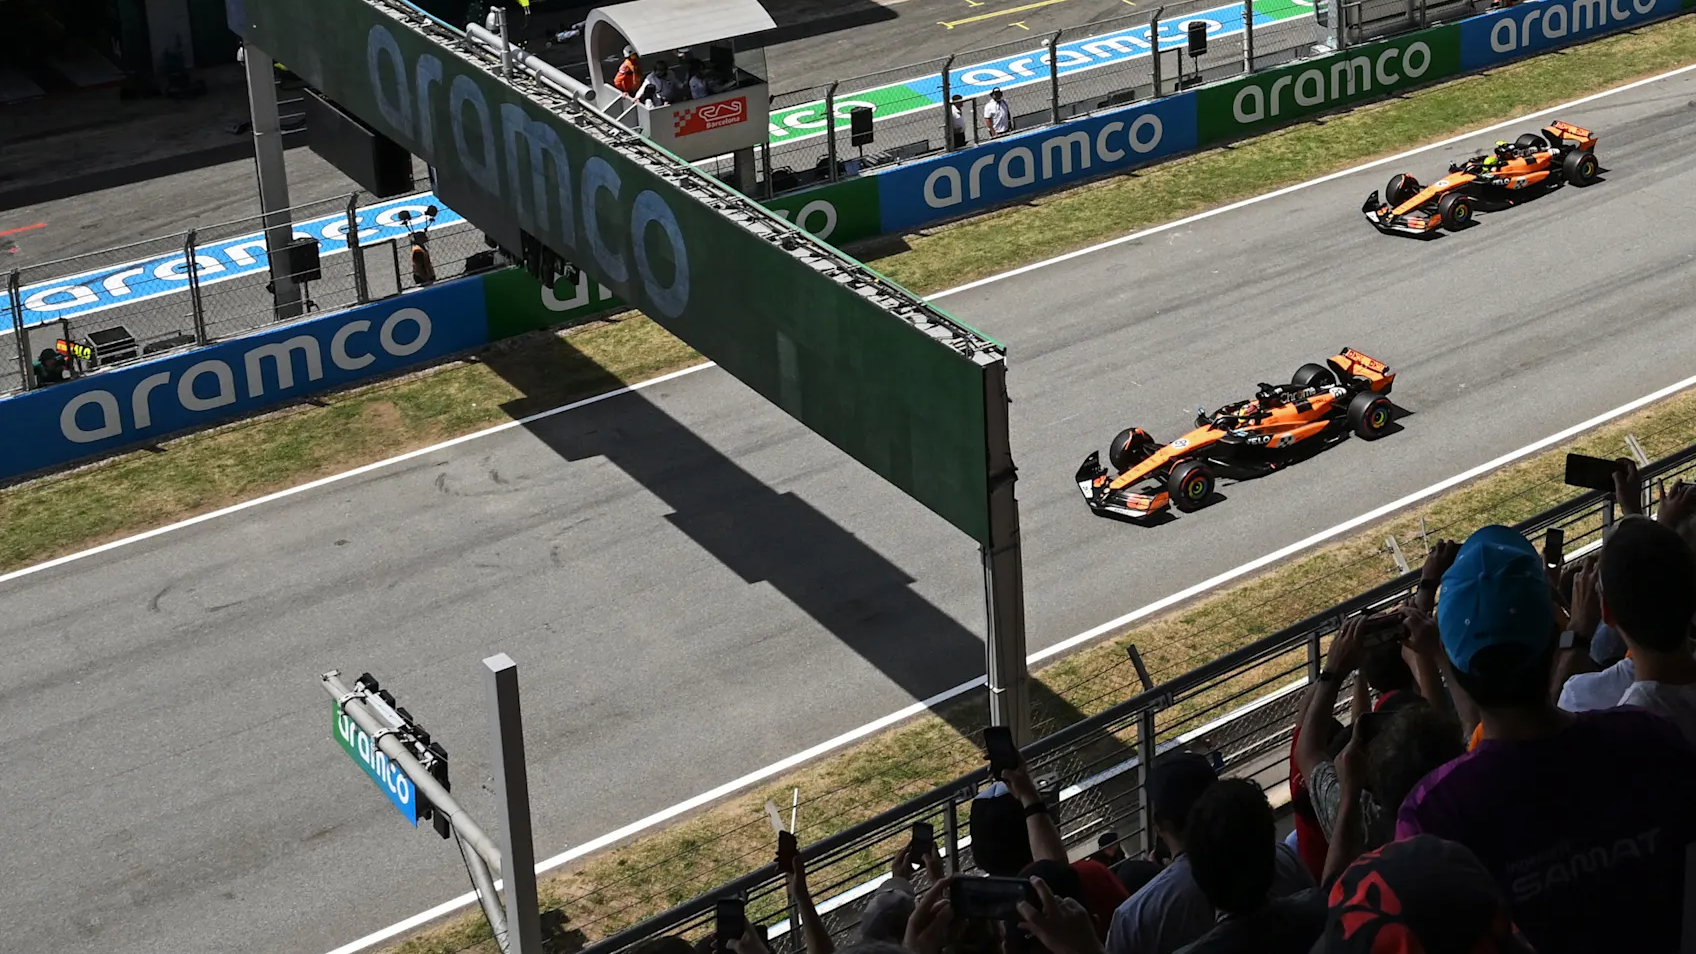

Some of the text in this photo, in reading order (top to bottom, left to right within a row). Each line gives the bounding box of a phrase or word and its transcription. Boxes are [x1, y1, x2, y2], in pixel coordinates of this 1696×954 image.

[961, 18, 1223, 86] aramco
[1233, 40, 1432, 123] aramco
[706, 116, 740, 129] Barcelona
[923, 113, 1163, 208] aramco
[367, 23, 690, 319] aramco
[60, 308, 432, 443] aramco
